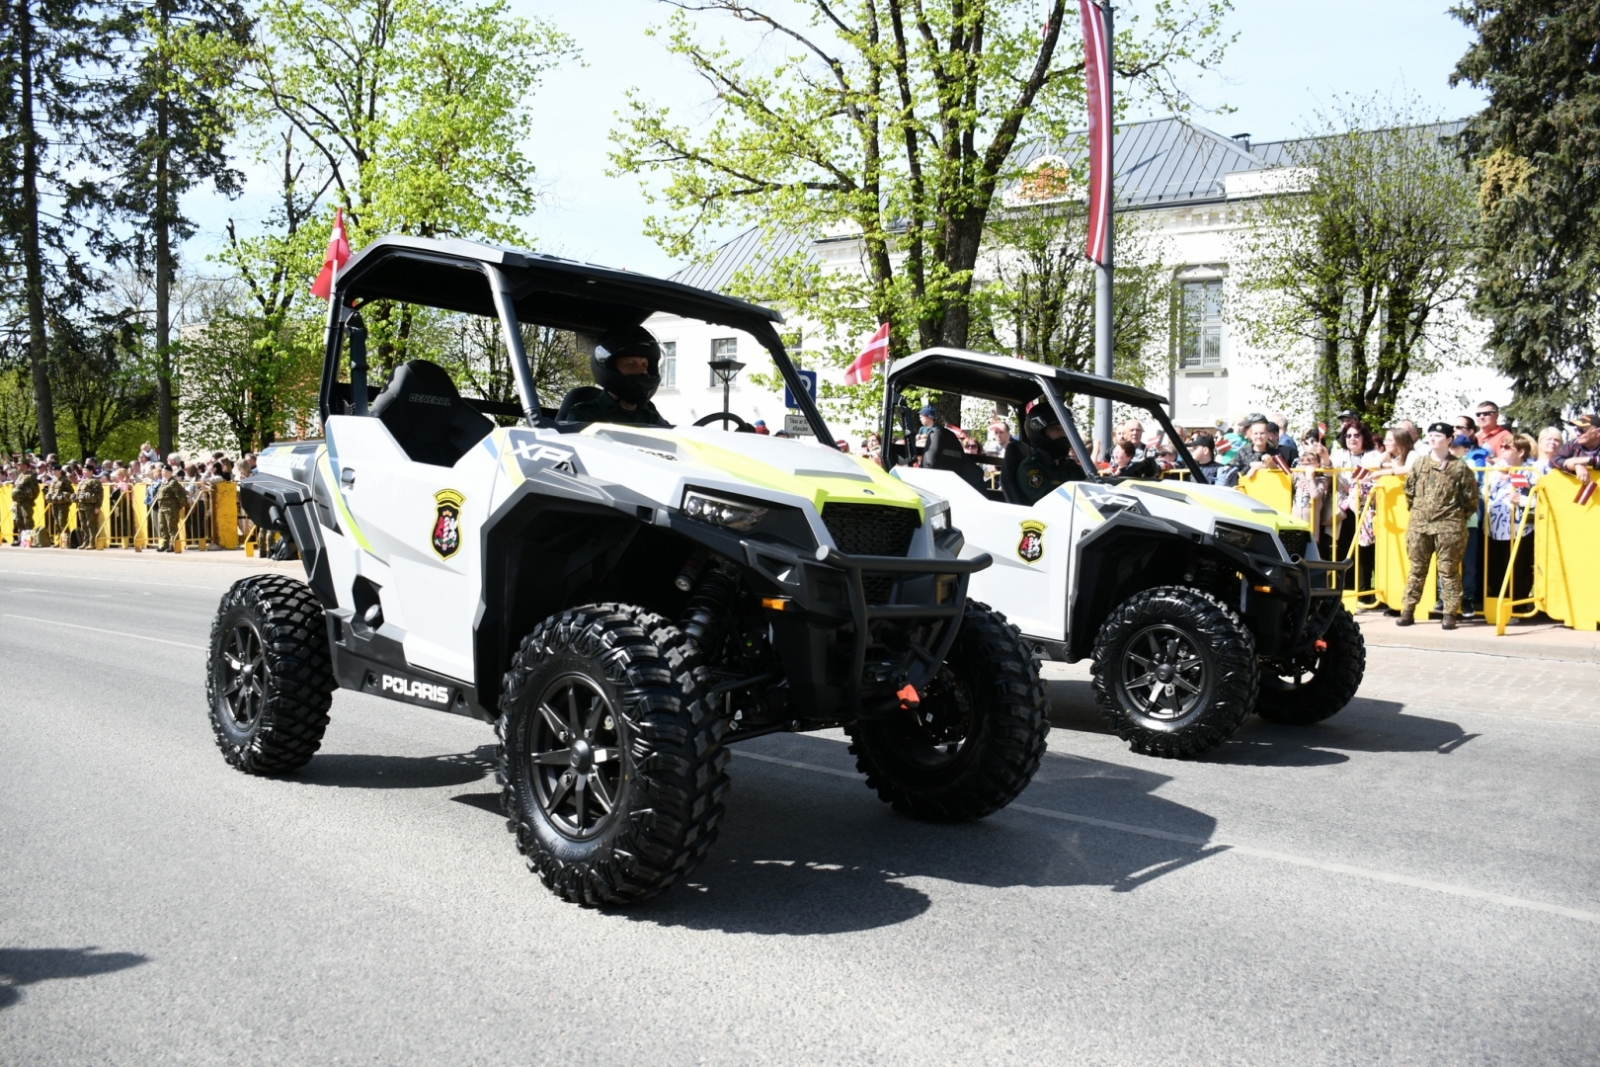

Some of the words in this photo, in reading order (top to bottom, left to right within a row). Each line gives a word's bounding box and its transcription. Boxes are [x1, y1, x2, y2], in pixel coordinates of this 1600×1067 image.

[408, 393, 452, 407] GENERAL
[505, 439, 574, 461] XP
[1081, 490, 1139, 506] XP
[382, 674, 449, 704] POLARIS
